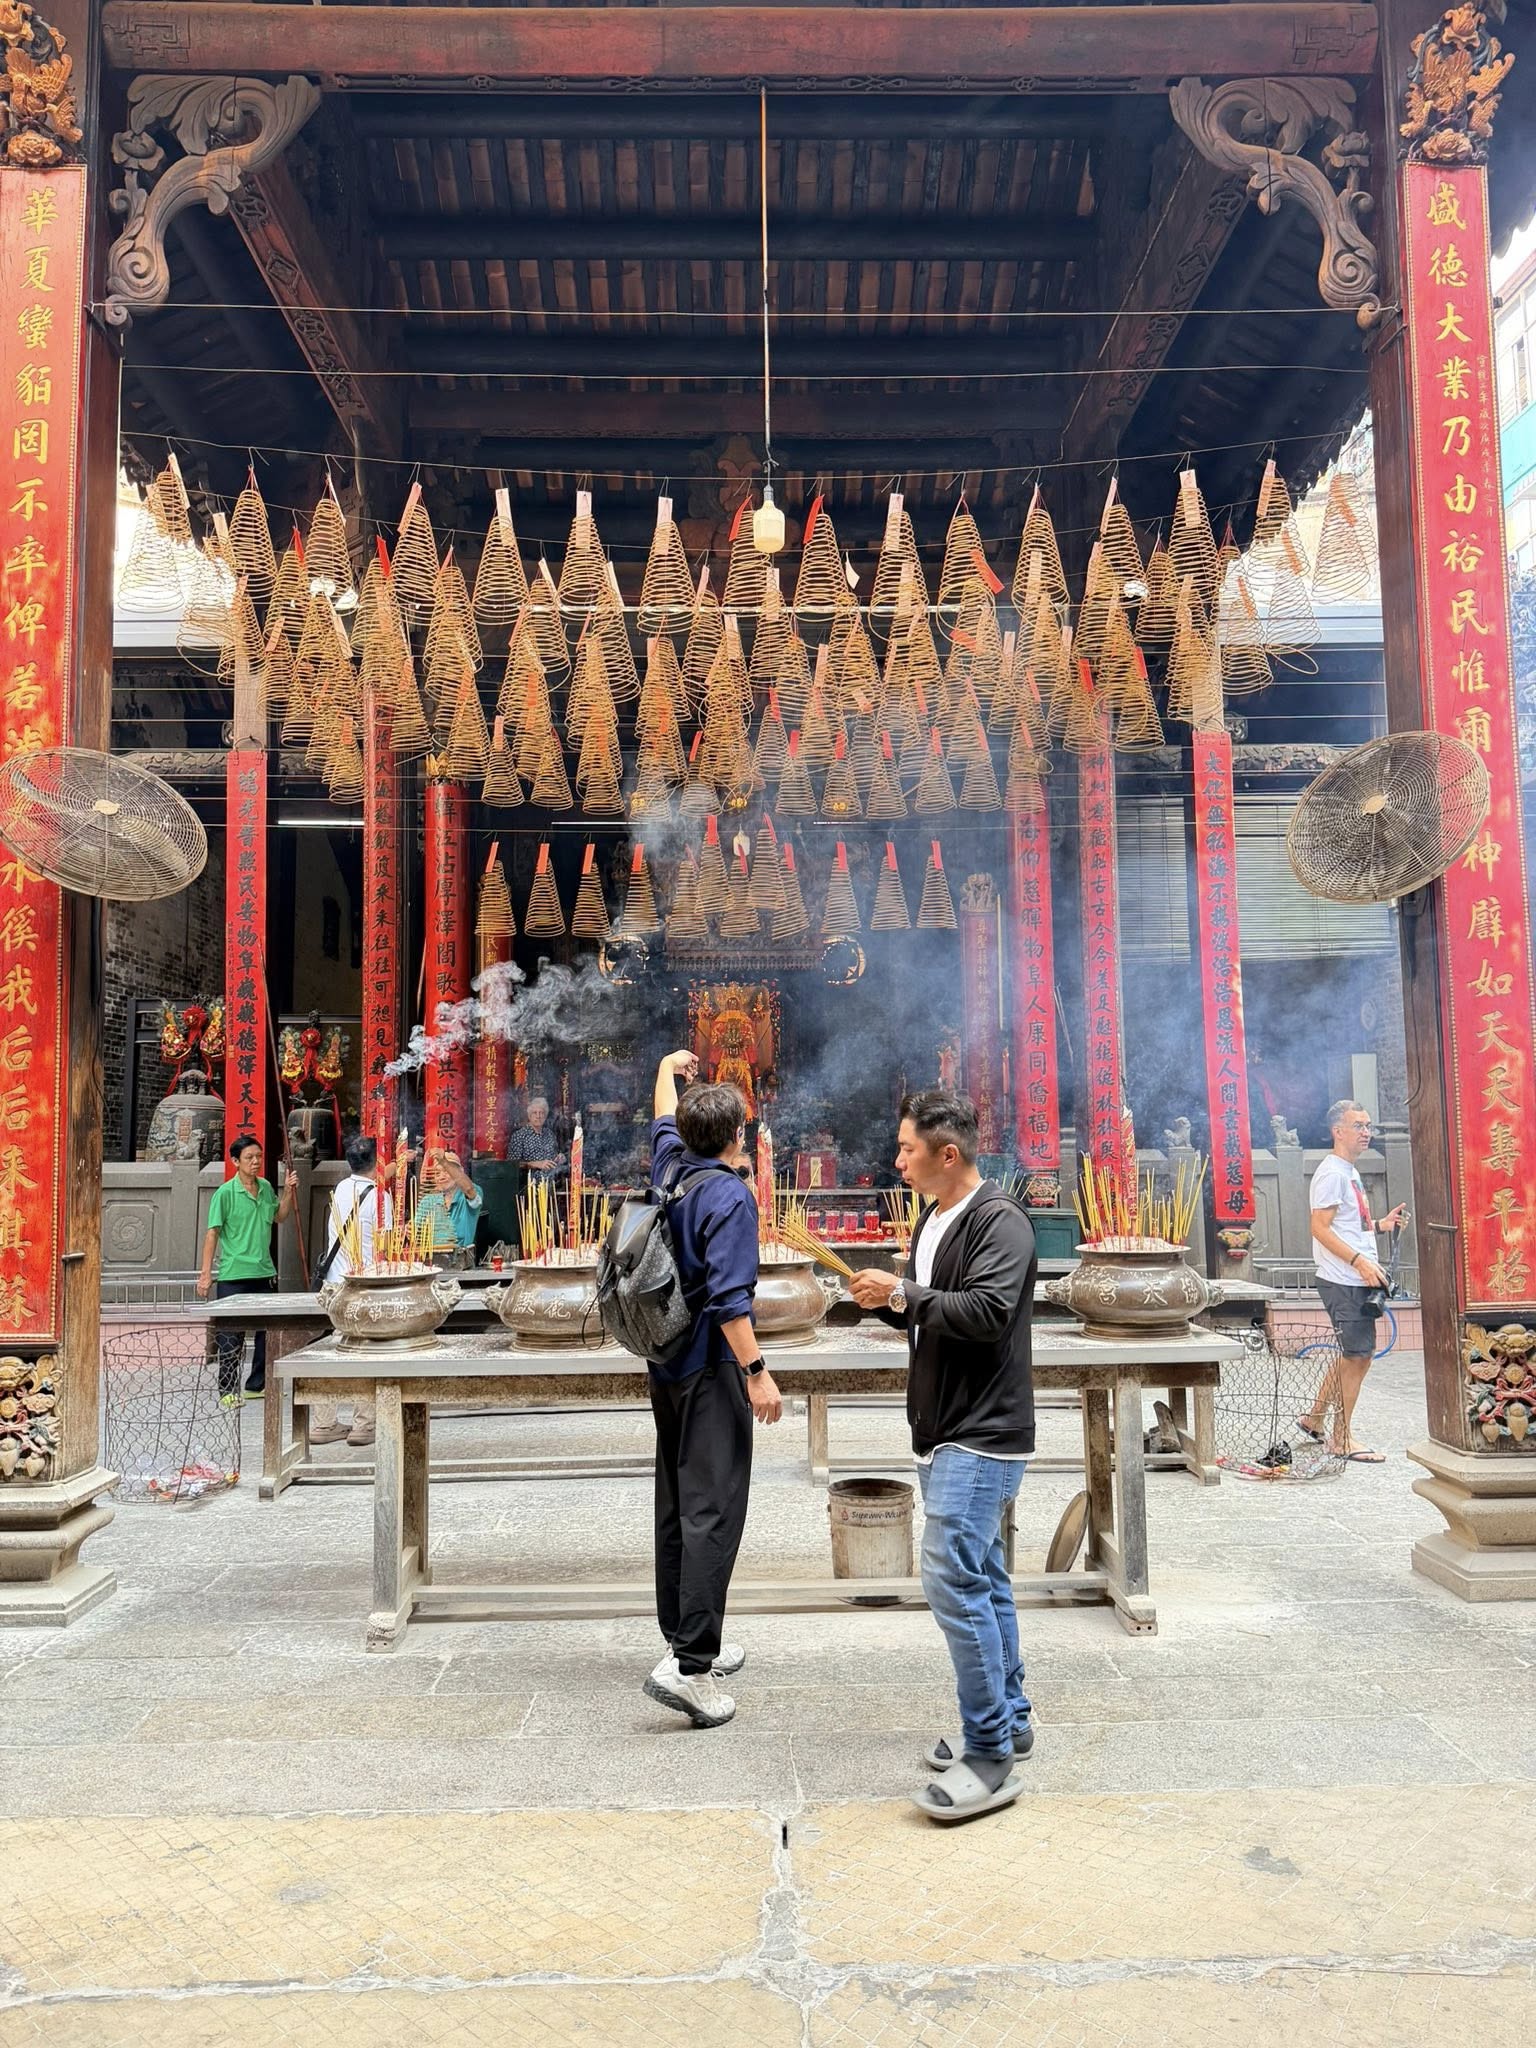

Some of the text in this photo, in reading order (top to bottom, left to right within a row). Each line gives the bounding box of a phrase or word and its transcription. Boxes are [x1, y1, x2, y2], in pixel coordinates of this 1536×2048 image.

[235, 767, 260, 1139] 鴻光普照民安物阜巍巍德澤天上
[434, 792, 459, 1153] 韓江沾厚澤閭歌共沐恩
[1019, 803, 1054, 1161] 海仰慈暉物阜人康同僑福地
